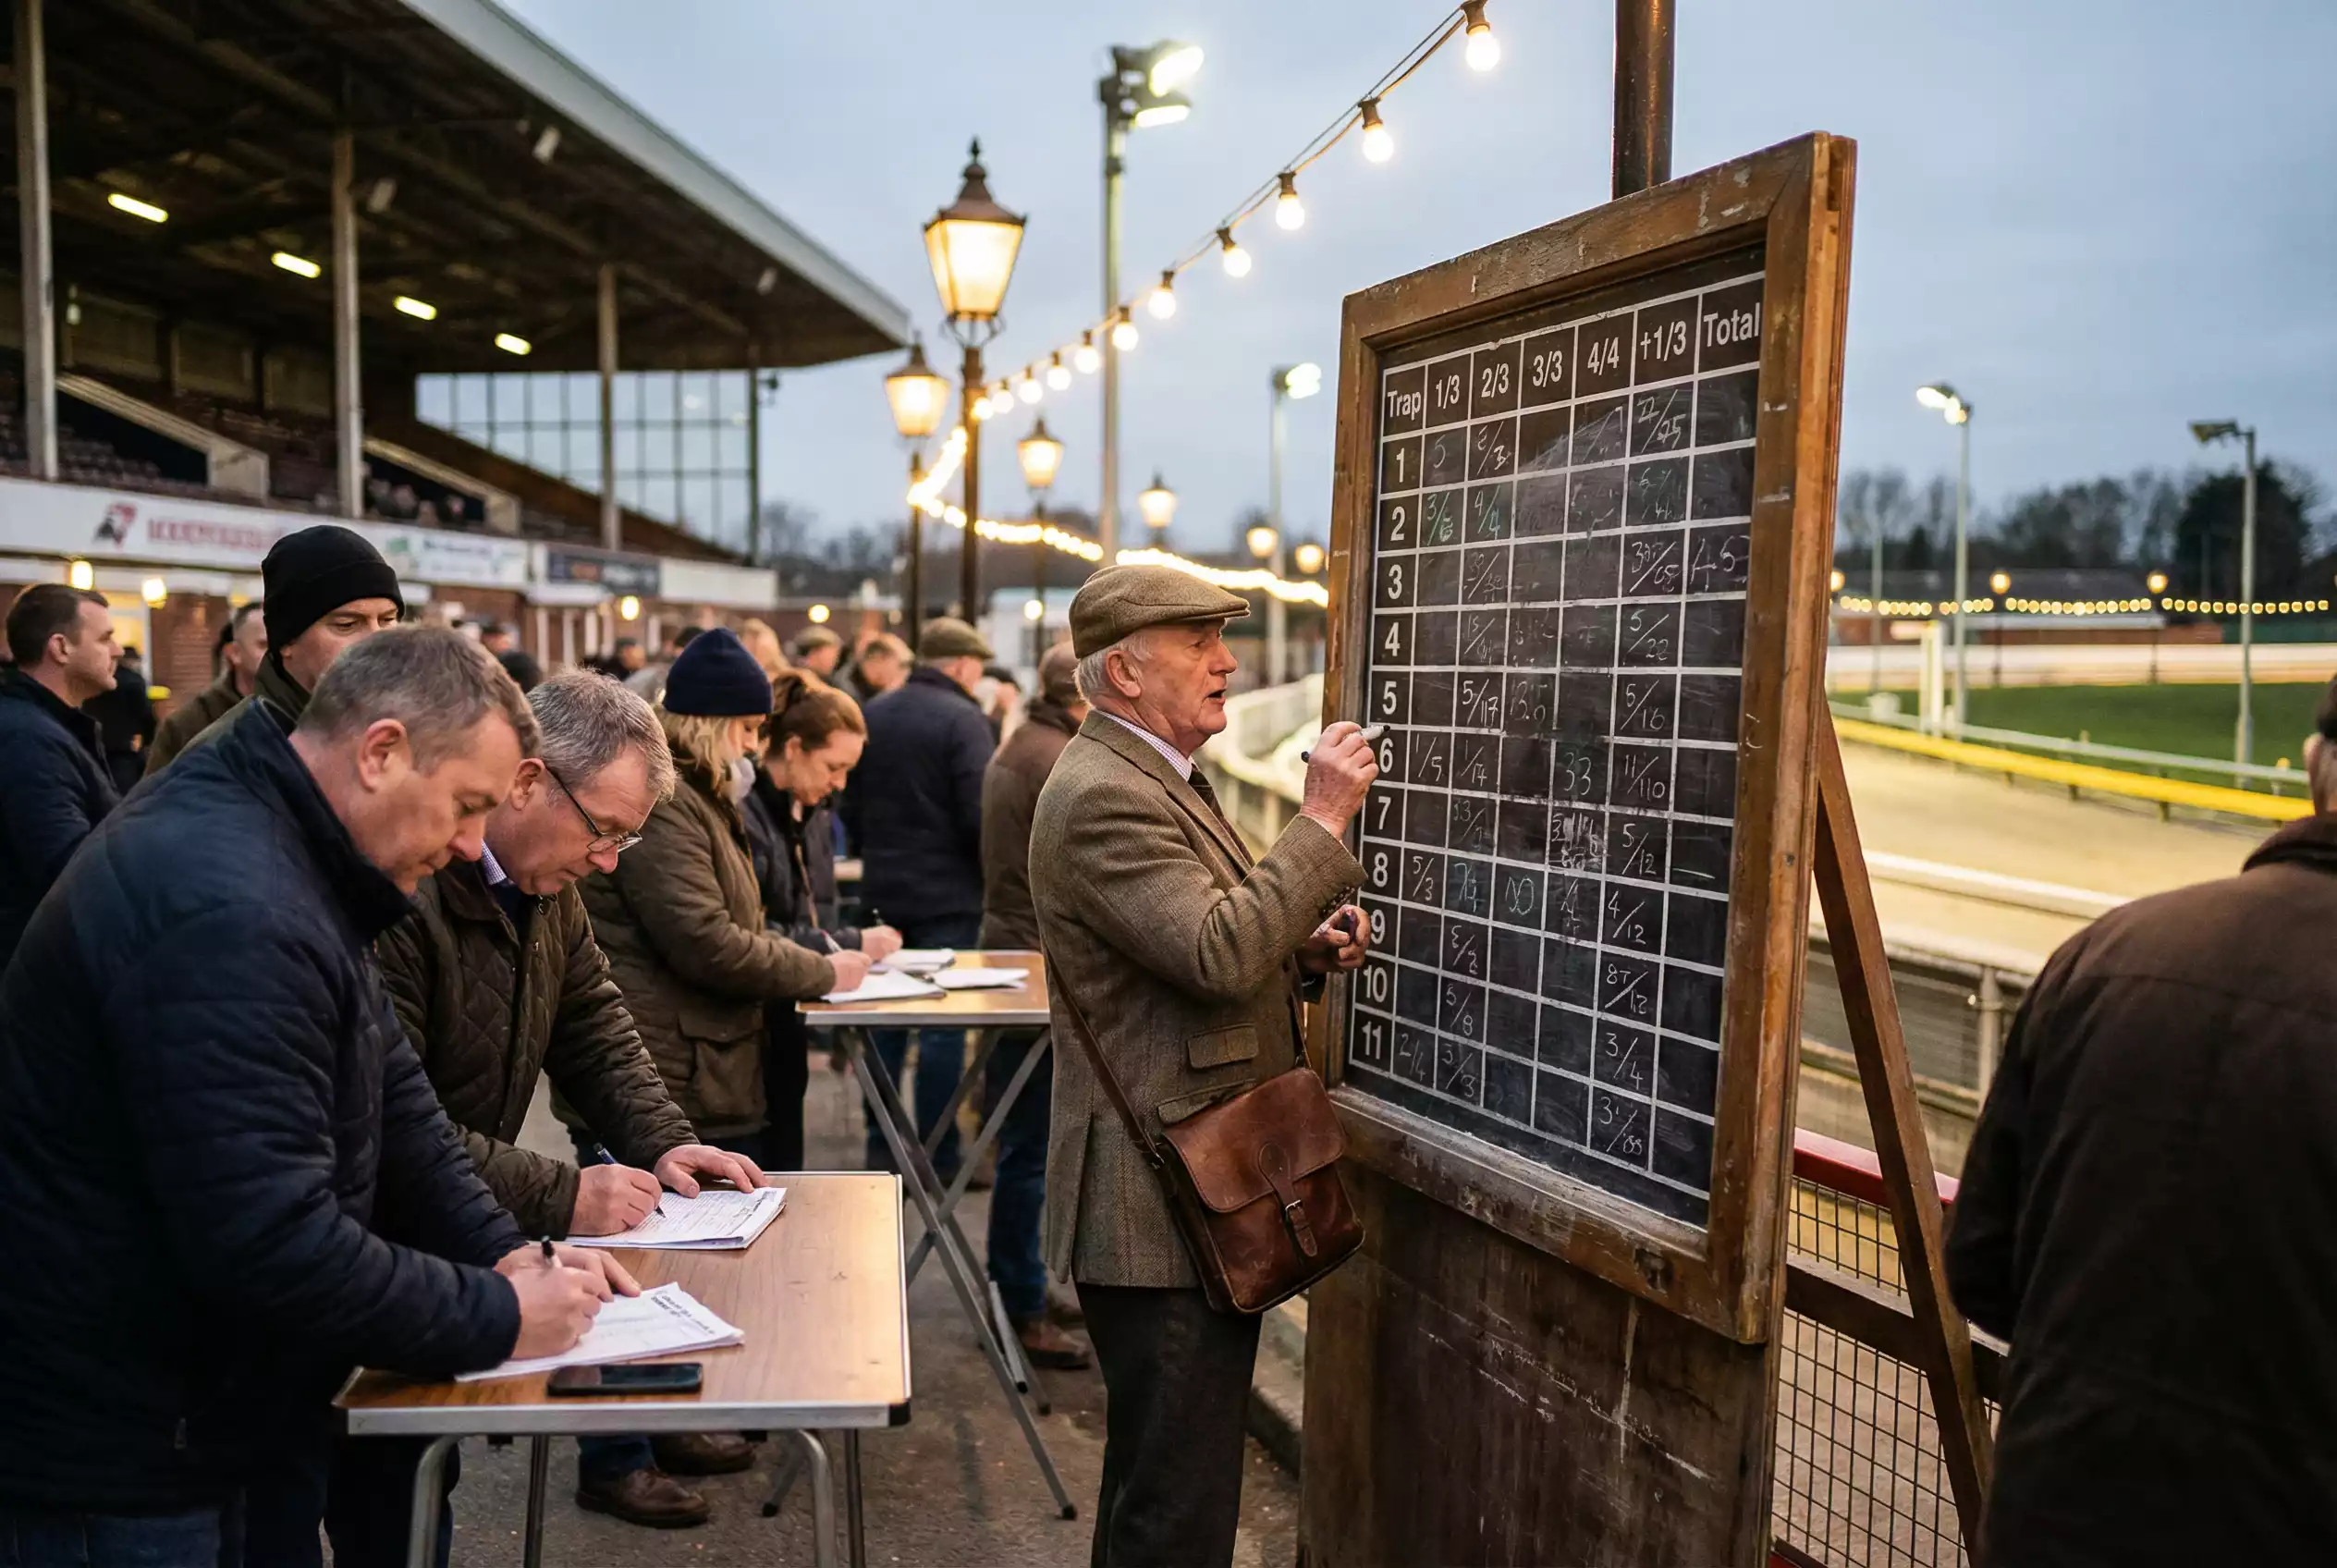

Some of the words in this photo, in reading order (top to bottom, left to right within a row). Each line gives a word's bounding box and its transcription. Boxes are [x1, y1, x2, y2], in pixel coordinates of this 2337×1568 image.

[1387, 389, 1422, 421] Trap
[1435, 374, 1461, 410] 1/3
[1480, 362, 1511, 398] 2/3
[1532, 350, 1563, 388] 3/3
[1586, 337, 1620, 376] 4/4
[1639, 320, 1687, 361] +1/3
[1703, 302, 1761, 348] Total
[1396, 447, 1405, 483] 1
[1390, 506, 1406, 542] 2
[1388, 564, 1402, 600] 3
[1385, 621, 1401, 657] 4
[1382, 680, 1398, 716] 5
[1379, 737, 1394, 774] 6
[1377, 795, 1391, 830] 7
[1621, 823, 1657, 876] 5/12
[1372, 851, 1388, 888] 8
[1370, 909, 1386, 945] 9
[1608, 890, 1646, 945] 4/12
[1363, 964, 1388, 1003] 10
[1362, 1020, 1382, 1060] 11
[1605, 1031, 1644, 1091] 3/4
